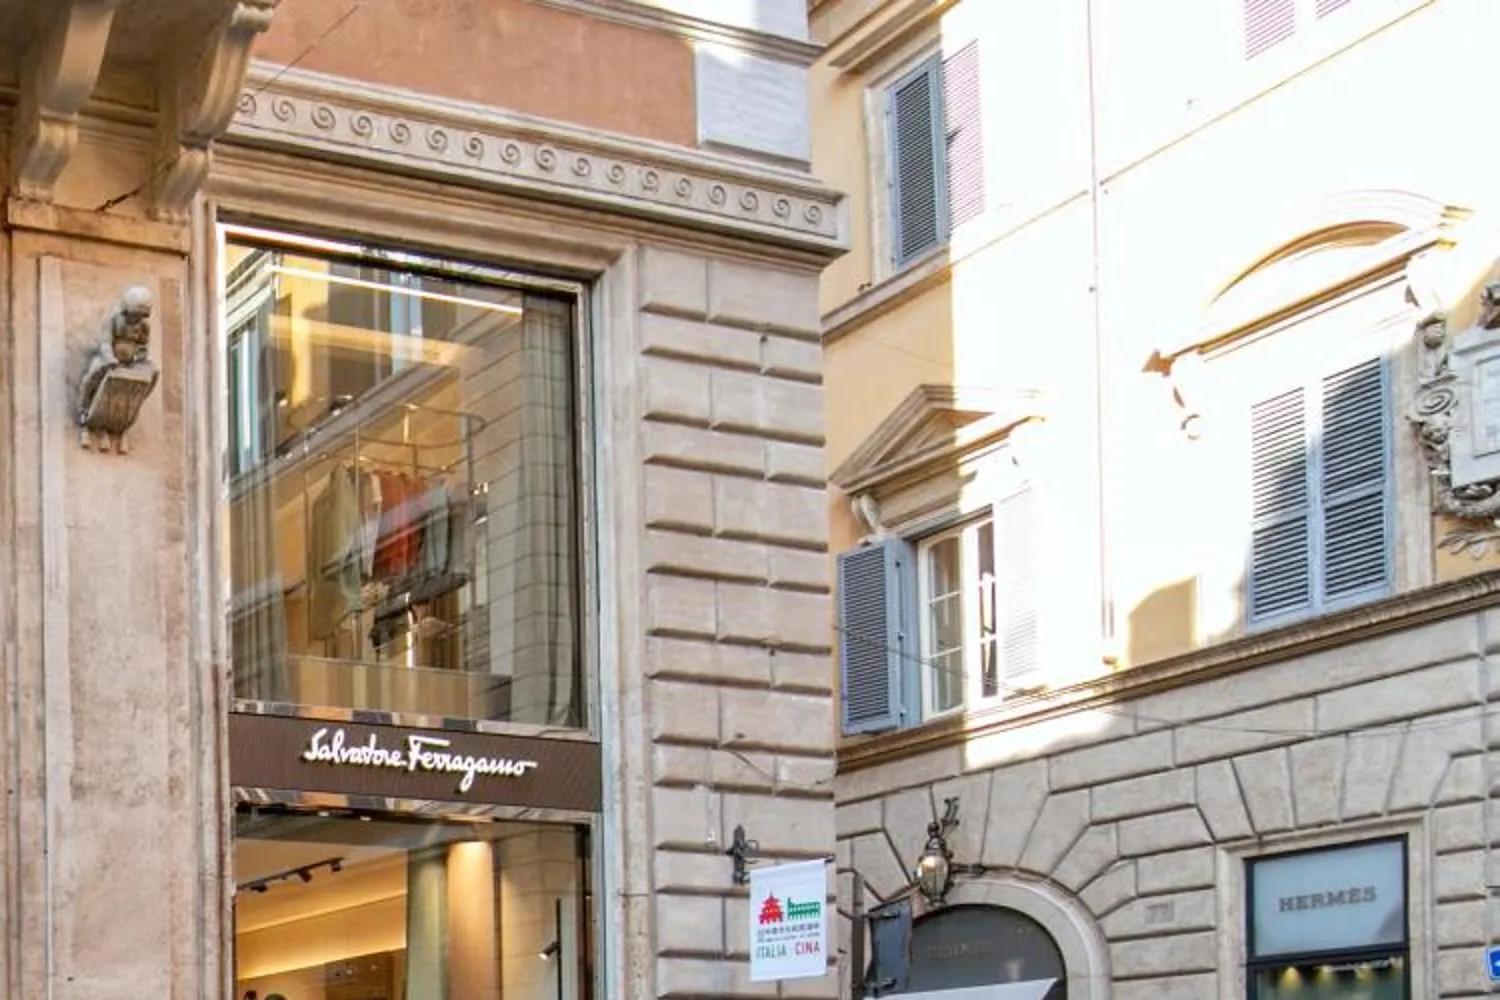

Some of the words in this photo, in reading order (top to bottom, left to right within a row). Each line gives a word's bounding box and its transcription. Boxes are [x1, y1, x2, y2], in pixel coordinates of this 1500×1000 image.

[303, 727, 407, 768] Salvatore
[408, 735, 538, 793] Ferragamo
[795, 939, 821, 956] CINA
